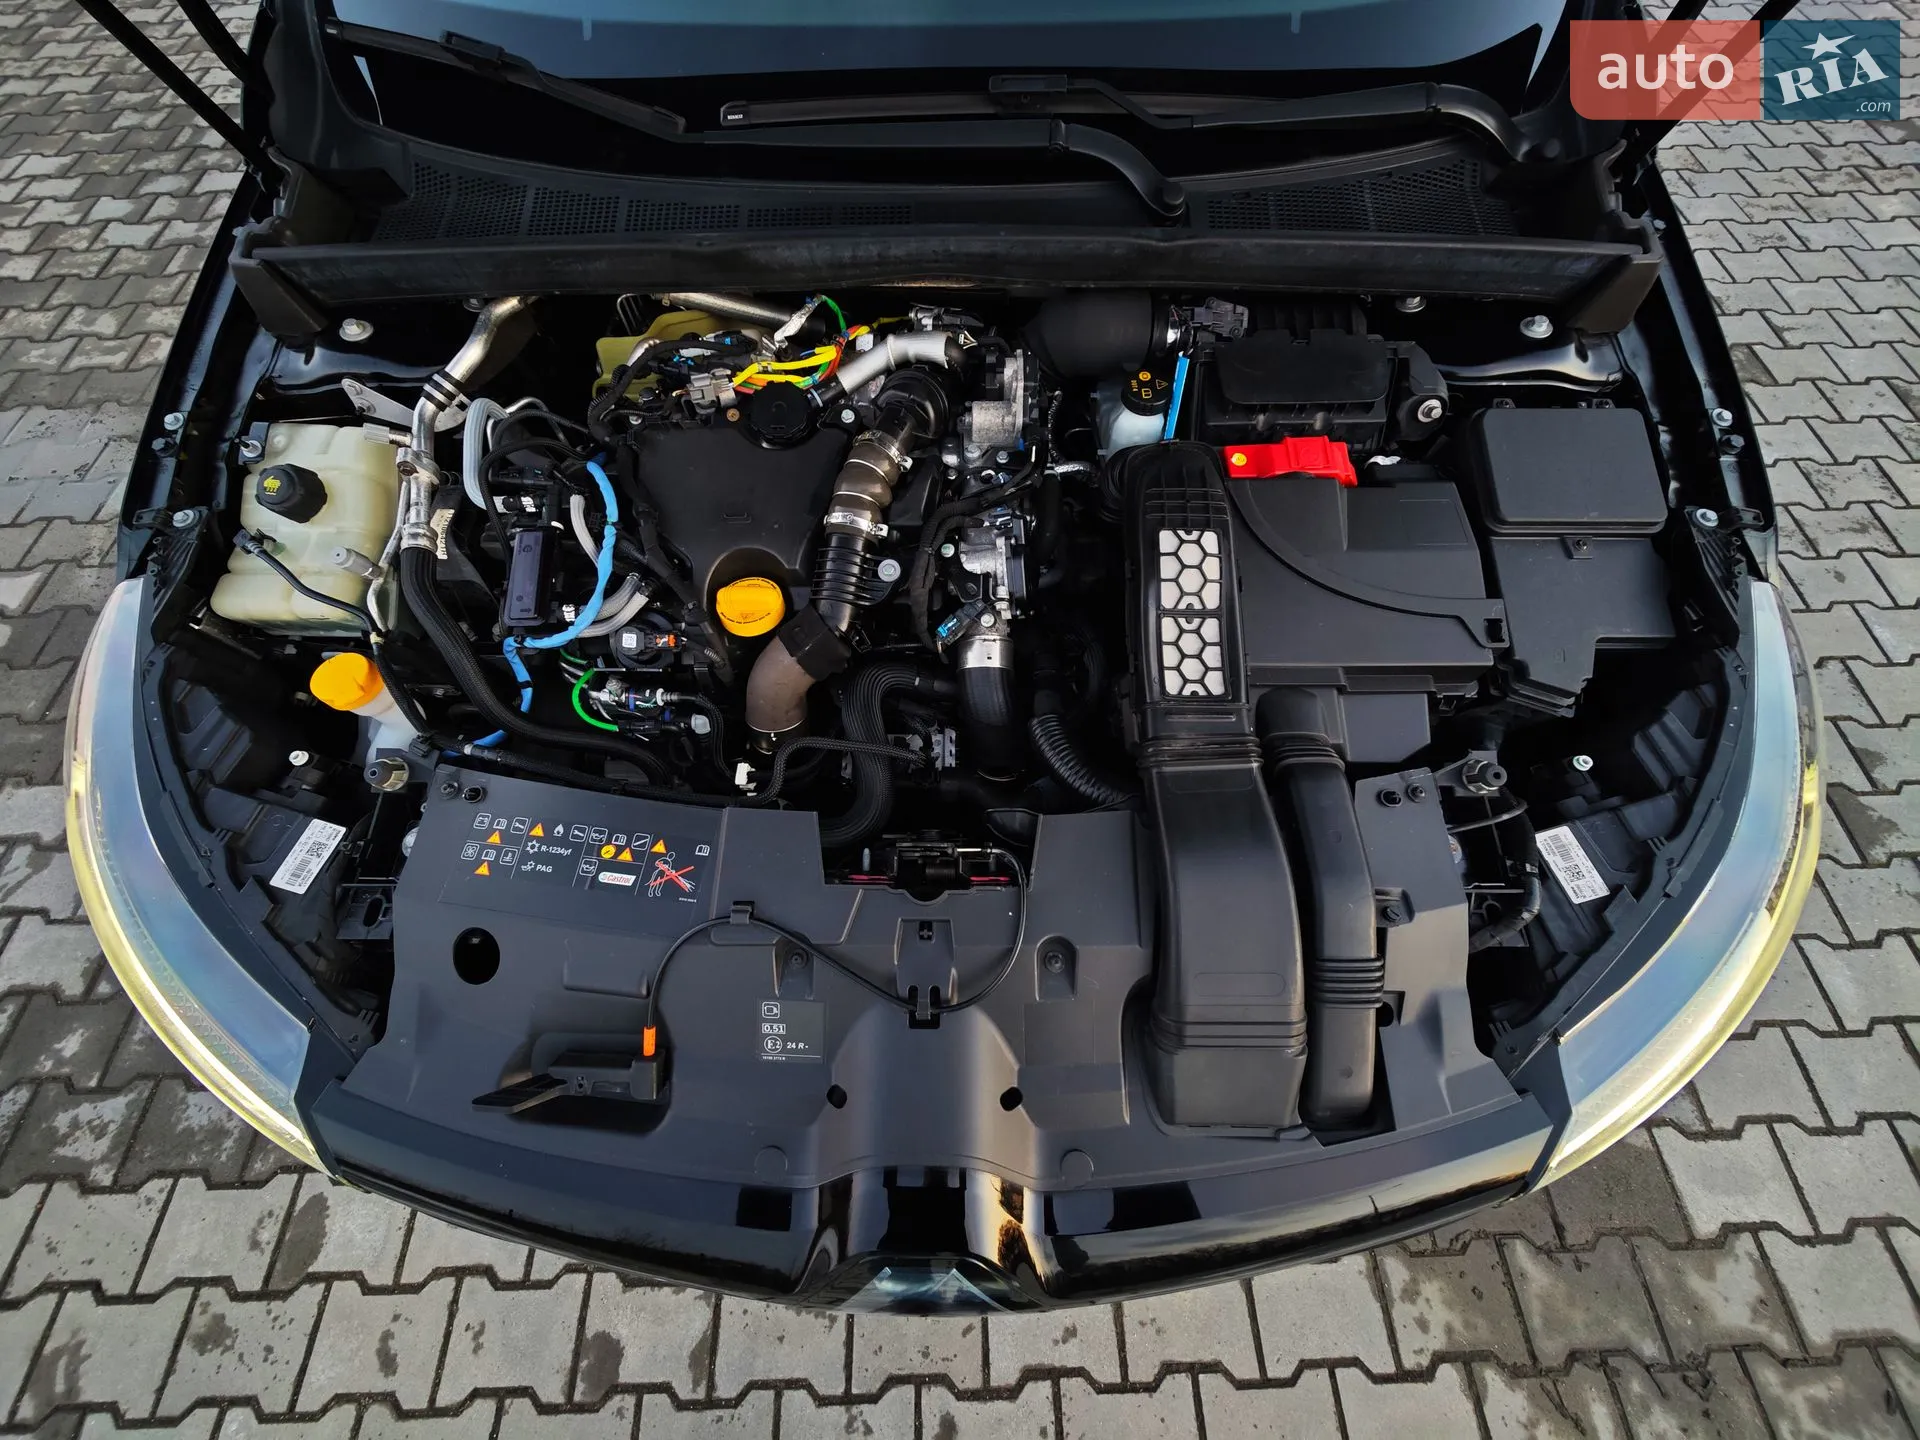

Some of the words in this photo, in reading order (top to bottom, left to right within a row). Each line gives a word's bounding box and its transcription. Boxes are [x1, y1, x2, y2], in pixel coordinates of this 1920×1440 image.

[541, 845, 572, 856] R-1234yf
[536, 864, 552, 872] PAG
[607, 874, 632, 884] Castrol
